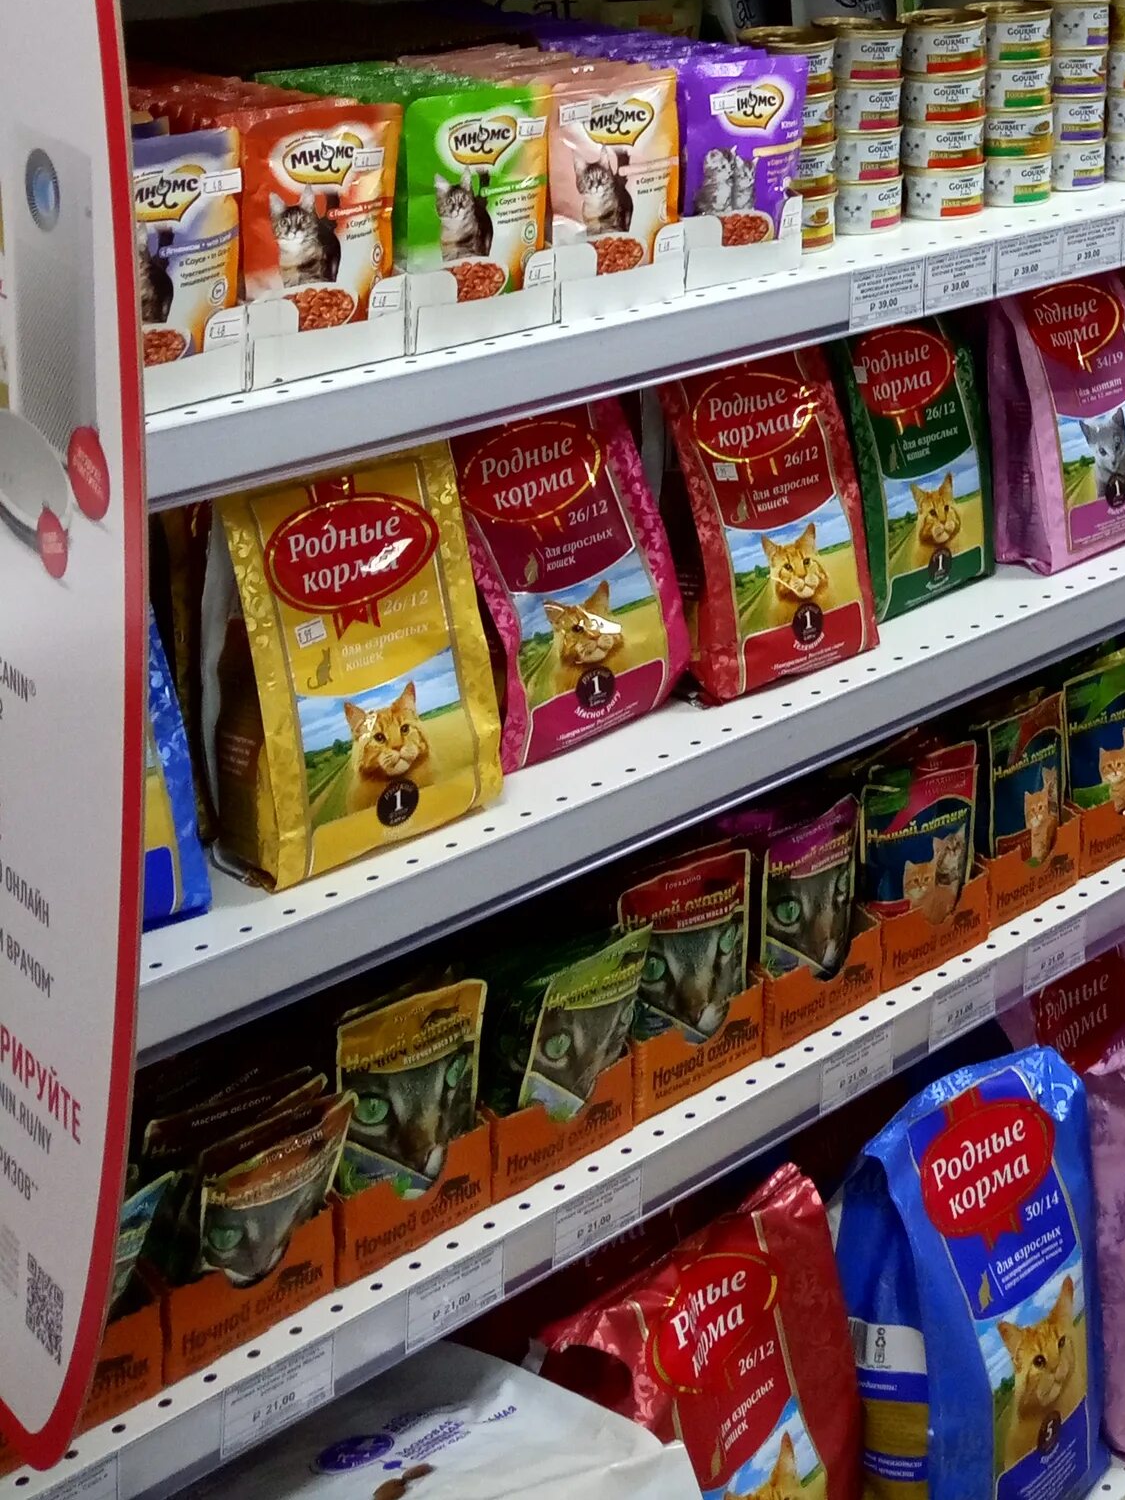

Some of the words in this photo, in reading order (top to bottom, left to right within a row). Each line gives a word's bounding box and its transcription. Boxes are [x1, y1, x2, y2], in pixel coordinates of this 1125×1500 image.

[933, 37, 970, 46] GOURMET
[1007, 27, 1040, 36] GOURMET
[861, 45, 895, 53] GOURMET
[1012, 73, 1044, 83] GOURMET
[1059, 62, 1093, 70] GOURMET
[933, 87, 970, 97] GOURMET
[1069, 108, 1099, 117] GOURMET
[936, 134, 972, 143] GOURMET
[988, 123, 1026, 131] GOURMET
[949, 180, 979, 190] GOURMET
[1022, 264, 1039, 274] 39,00
[951, 280, 969, 291] 39,00
[1033, 295, 1099, 327] Родные
[1049, 322, 1101, 350] корма
[862, 342, 931, 376] Родные
[1096, 350, 1124, 371] 34/19
[872, 368, 933, 403] корма
[708, 386, 787, 423] Родные
[925, 400, 956, 422] 26/12
[717, 412, 807, 450] корма
[902, 435, 920, 451] для
[922, 425, 959, 449] взрослых
[479, 434, 574, 486] Родные
[784, 445, 819, 470] 26/12
[906, 443, 931, 460] кошек
[492, 466, 575, 513] корма
[752, 488, 770, 504] для
[772, 472, 820, 500] взрослых
[567, 499, 609, 526] 26/12
[756, 495, 790, 513] кошек
[287, 513, 402, 563] Родные
[544, 543, 562, 561] для
[563, 525, 613, 558] взрослых
[301, 554, 400, 595] корма
[546, 554, 576, 573] кошек
[383, 589, 430, 617] 26/12
[365, 619, 430, 653] взрослых
[345, 650, 384, 673] кошек
[1088, 826, 1125, 853] Ночной
[5, 866, 50, 928] ОНЛАЙН
[996, 879, 1035, 910] Ночной
[892, 934, 939, 968] Ночной
[1048, 952, 1065, 967] 21,00
[780, 995, 825, 1030] Ночной
[954, 1002, 974, 1019] 21,00
[1045, 972, 1109, 1031] Родные
[1055, 1003, 1109, 1053] корма
[652, 1050, 704, 1090] Ночной
[848, 1066, 868, 1084] 21,00
[506, 1132, 565, 1177] Ночной
[931, 1119, 1027, 1192] Родные
[949, 1153, 1031, 1220] корма
[1025, 1190, 1060, 1222] 30/14
[355, 1215, 408, 1261] Ночной
[587, 1214, 612, 1234] 21,00
[996, 1256, 1014, 1275] для
[1014, 1226, 1061, 1267] взрослых
[444, 1292, 471, 1315] 21,00
[181, 1297, 250, 1354] Ночной
[737, 1340, 775, 1377] 26/12
[266, 1390, 297, 1411] 21,00
[732, 1376, 775, 1424] взрослых
